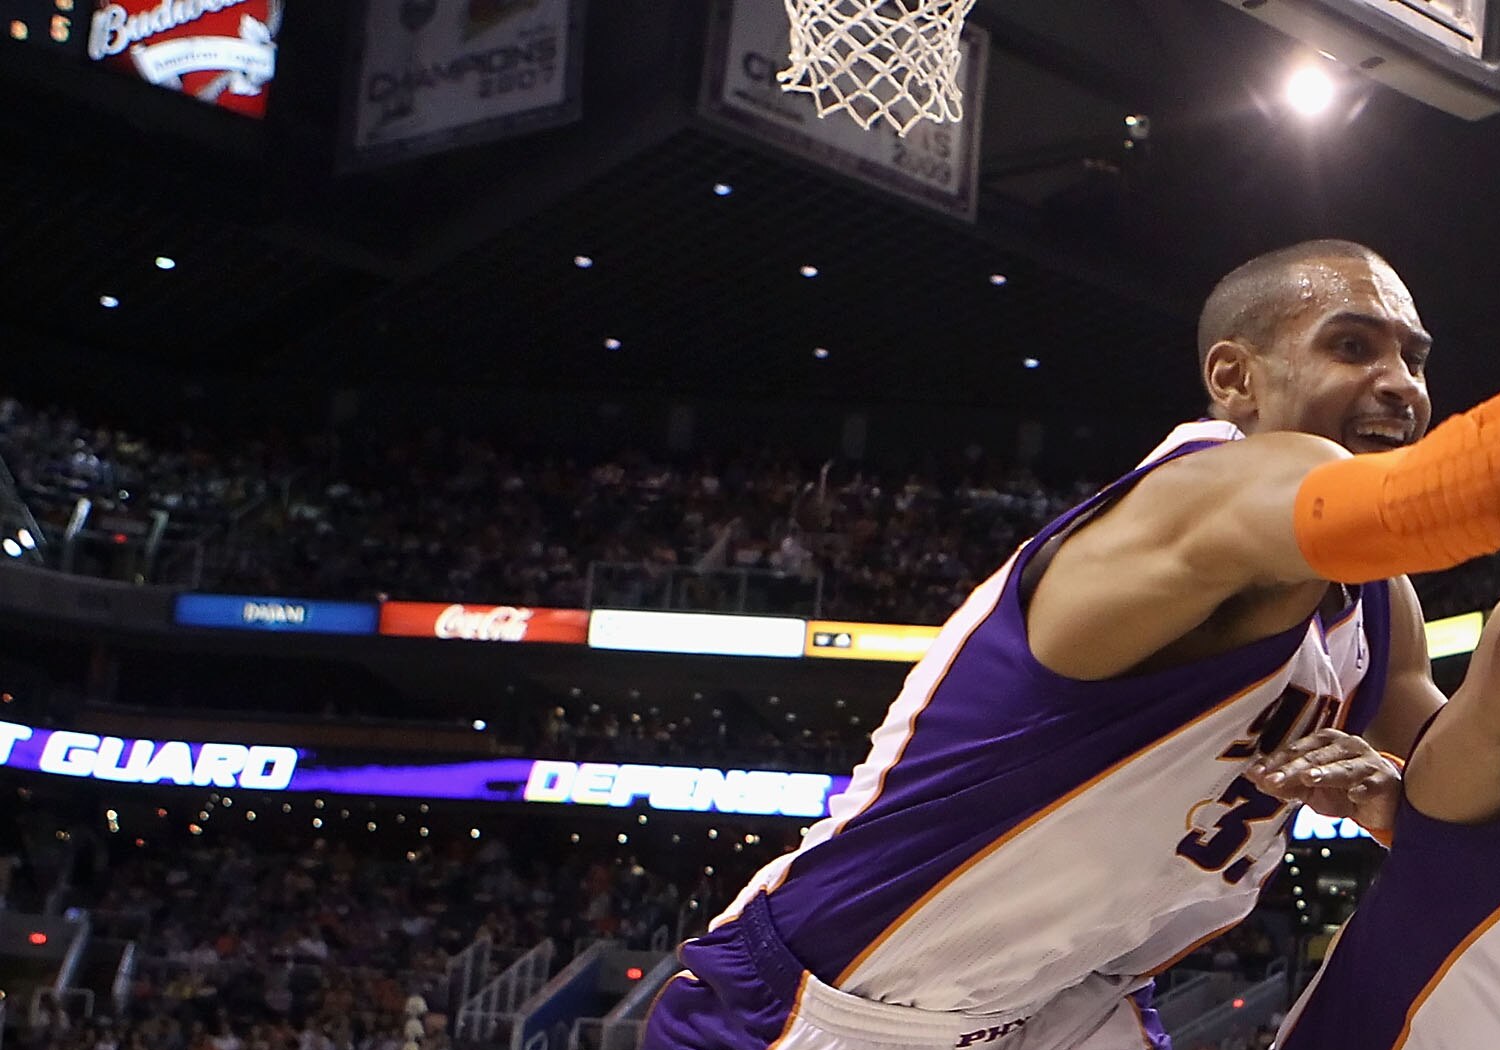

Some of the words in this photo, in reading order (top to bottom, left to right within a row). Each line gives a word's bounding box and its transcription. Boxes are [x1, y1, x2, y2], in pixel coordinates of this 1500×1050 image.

[40, 730, 298, 790] GUARD
[523, 760, 833, 818] DEFENSE
[1176, 774, 1287, 885] 3
